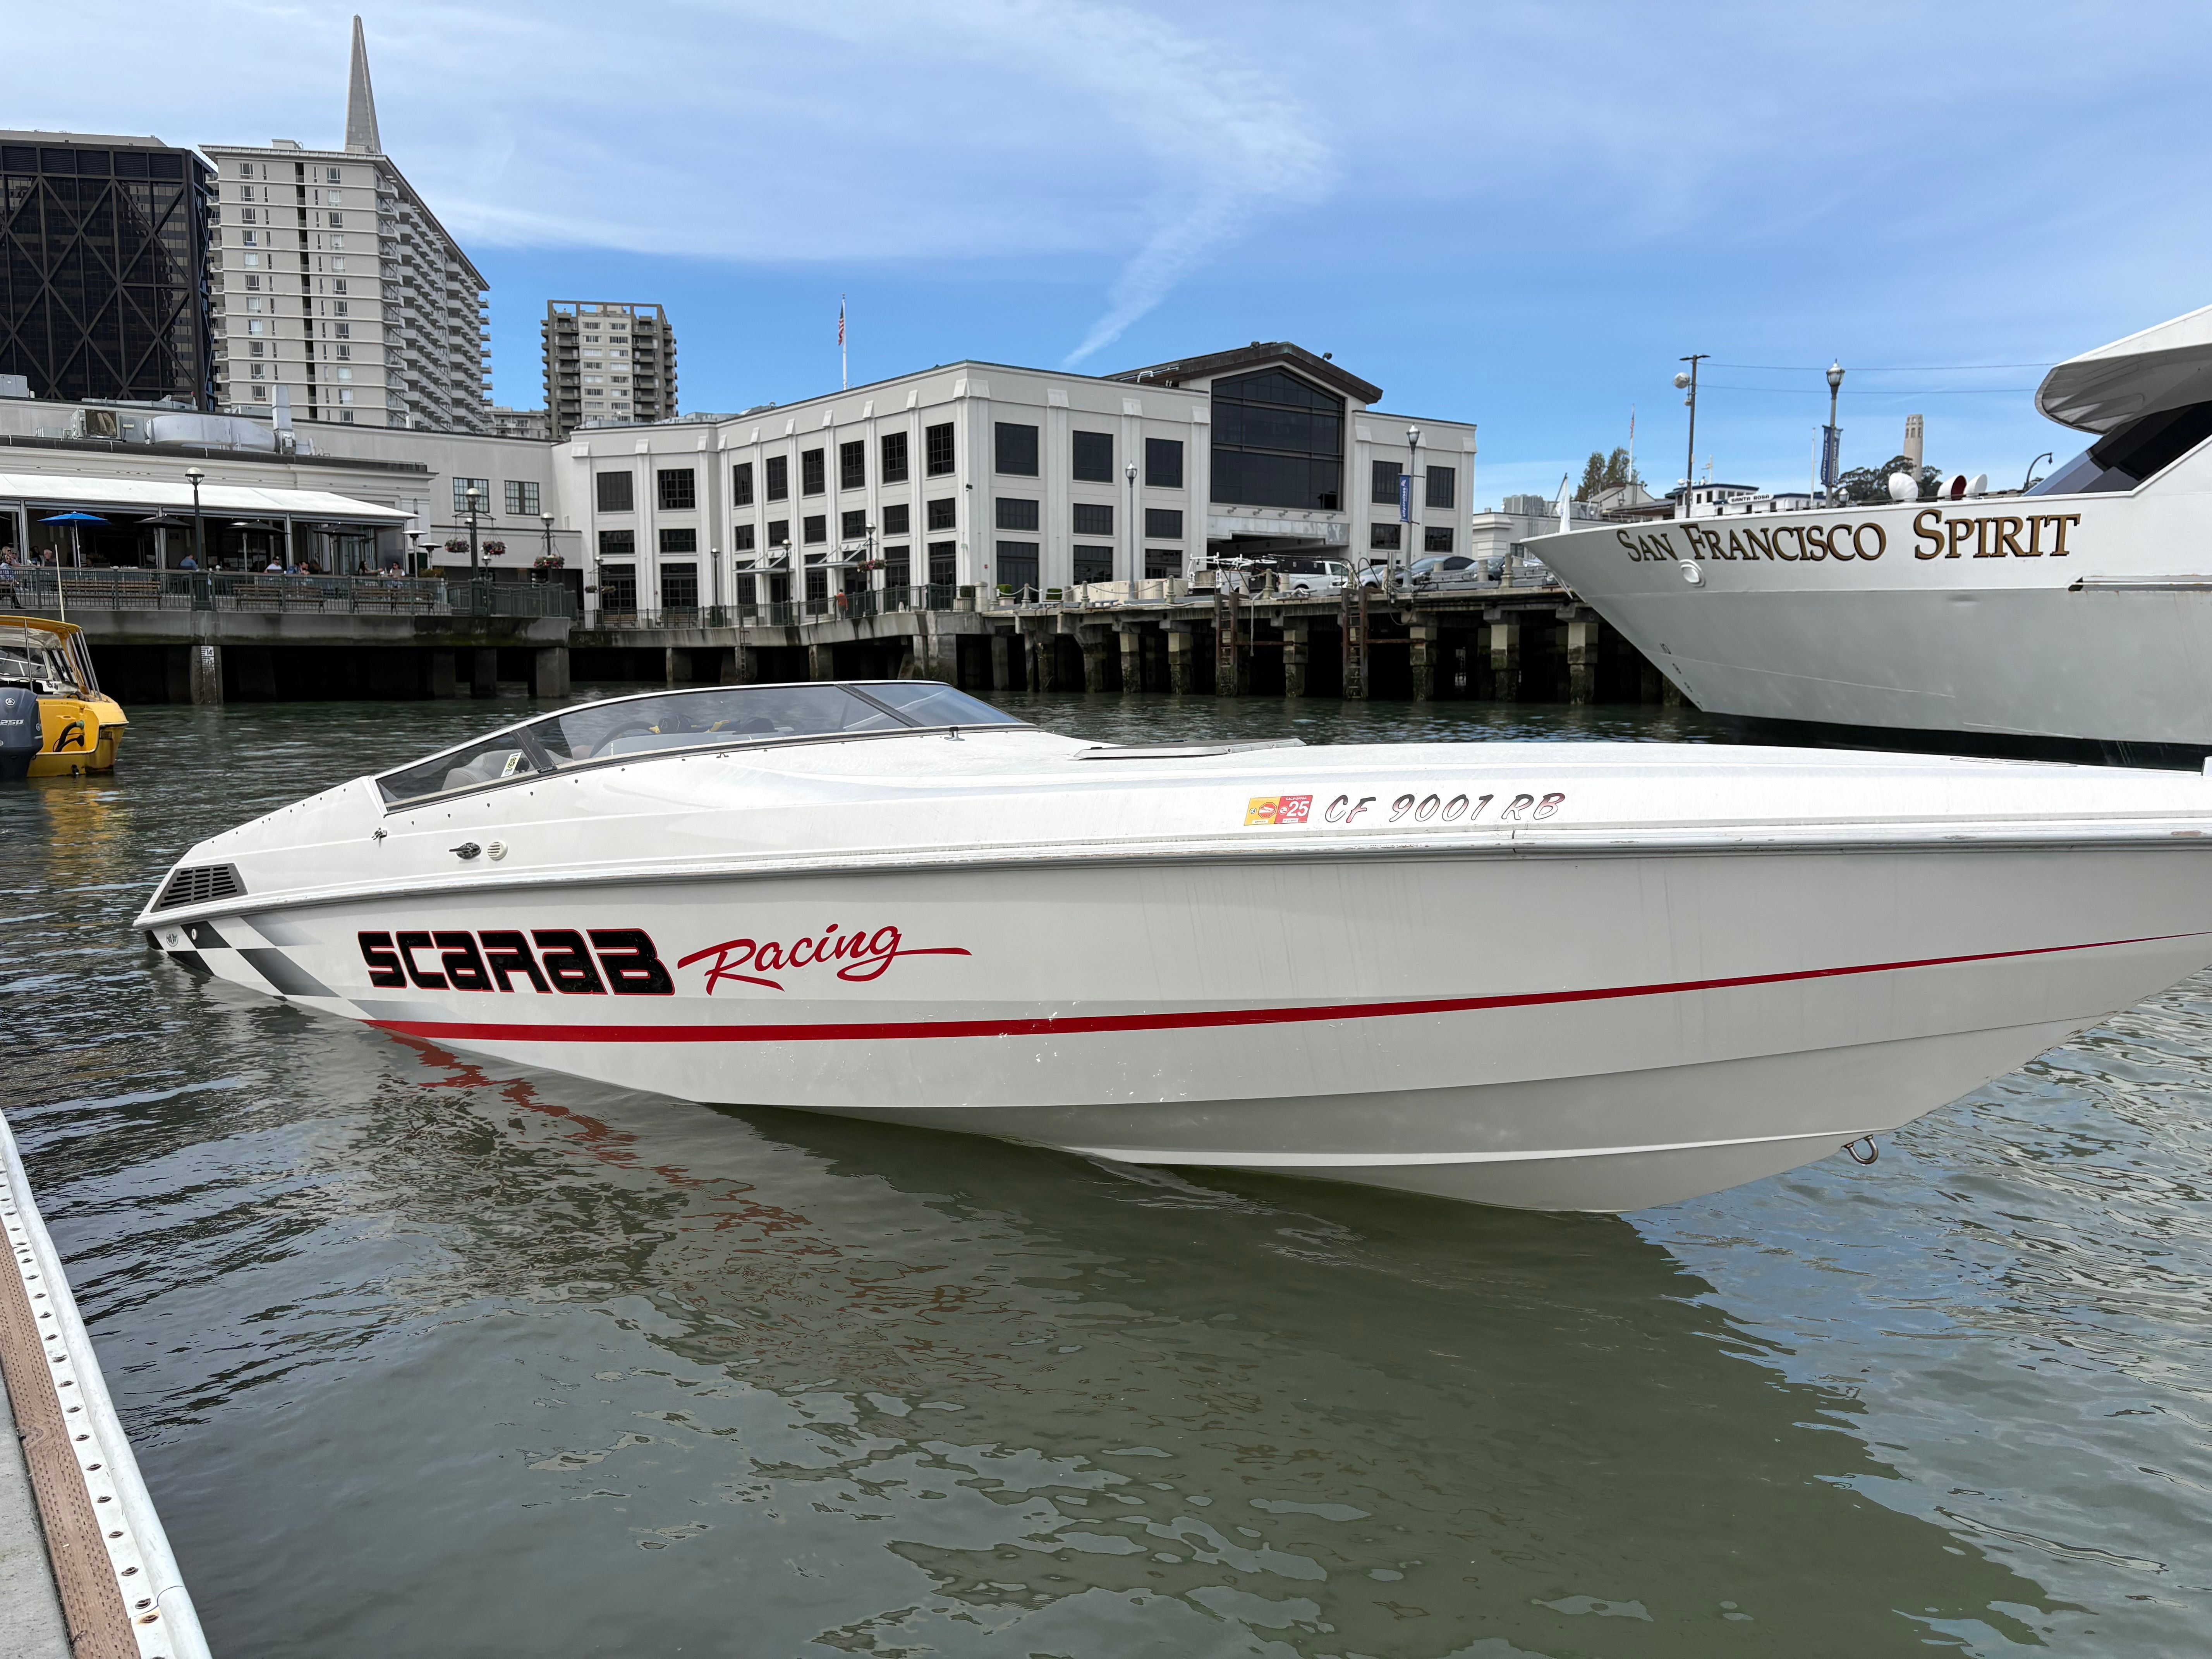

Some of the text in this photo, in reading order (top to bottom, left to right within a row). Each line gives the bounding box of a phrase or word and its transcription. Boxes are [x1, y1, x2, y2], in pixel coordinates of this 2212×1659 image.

[1616, 509, 2081, 562] SAN FRANCISCO SPIRIT
[1286, 801, 1310, 816] 25
[1325, 793, 1565, 823] CF 9001 RB
[358, 924, 972, 996] SCARAB Racing
